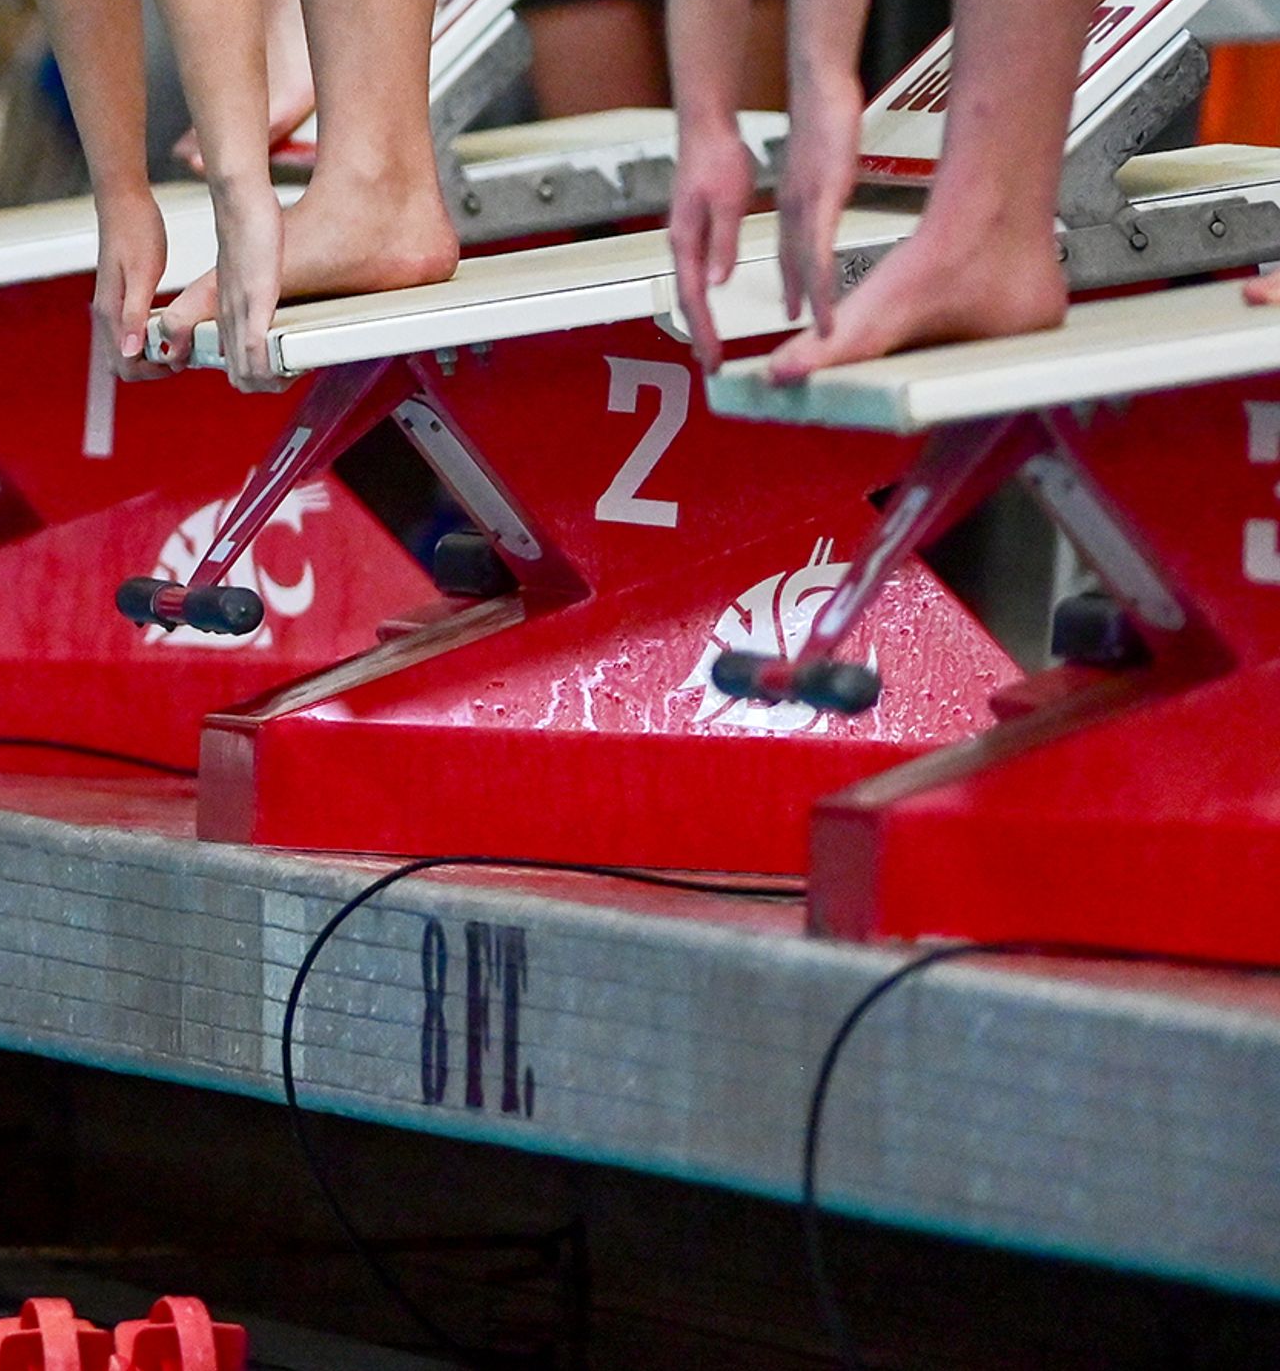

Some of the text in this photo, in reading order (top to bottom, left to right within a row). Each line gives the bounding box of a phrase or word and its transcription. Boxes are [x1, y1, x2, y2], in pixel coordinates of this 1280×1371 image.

[594, 355, 692, 529] 2
[420, 916, 536, 1120] 8 FT.
